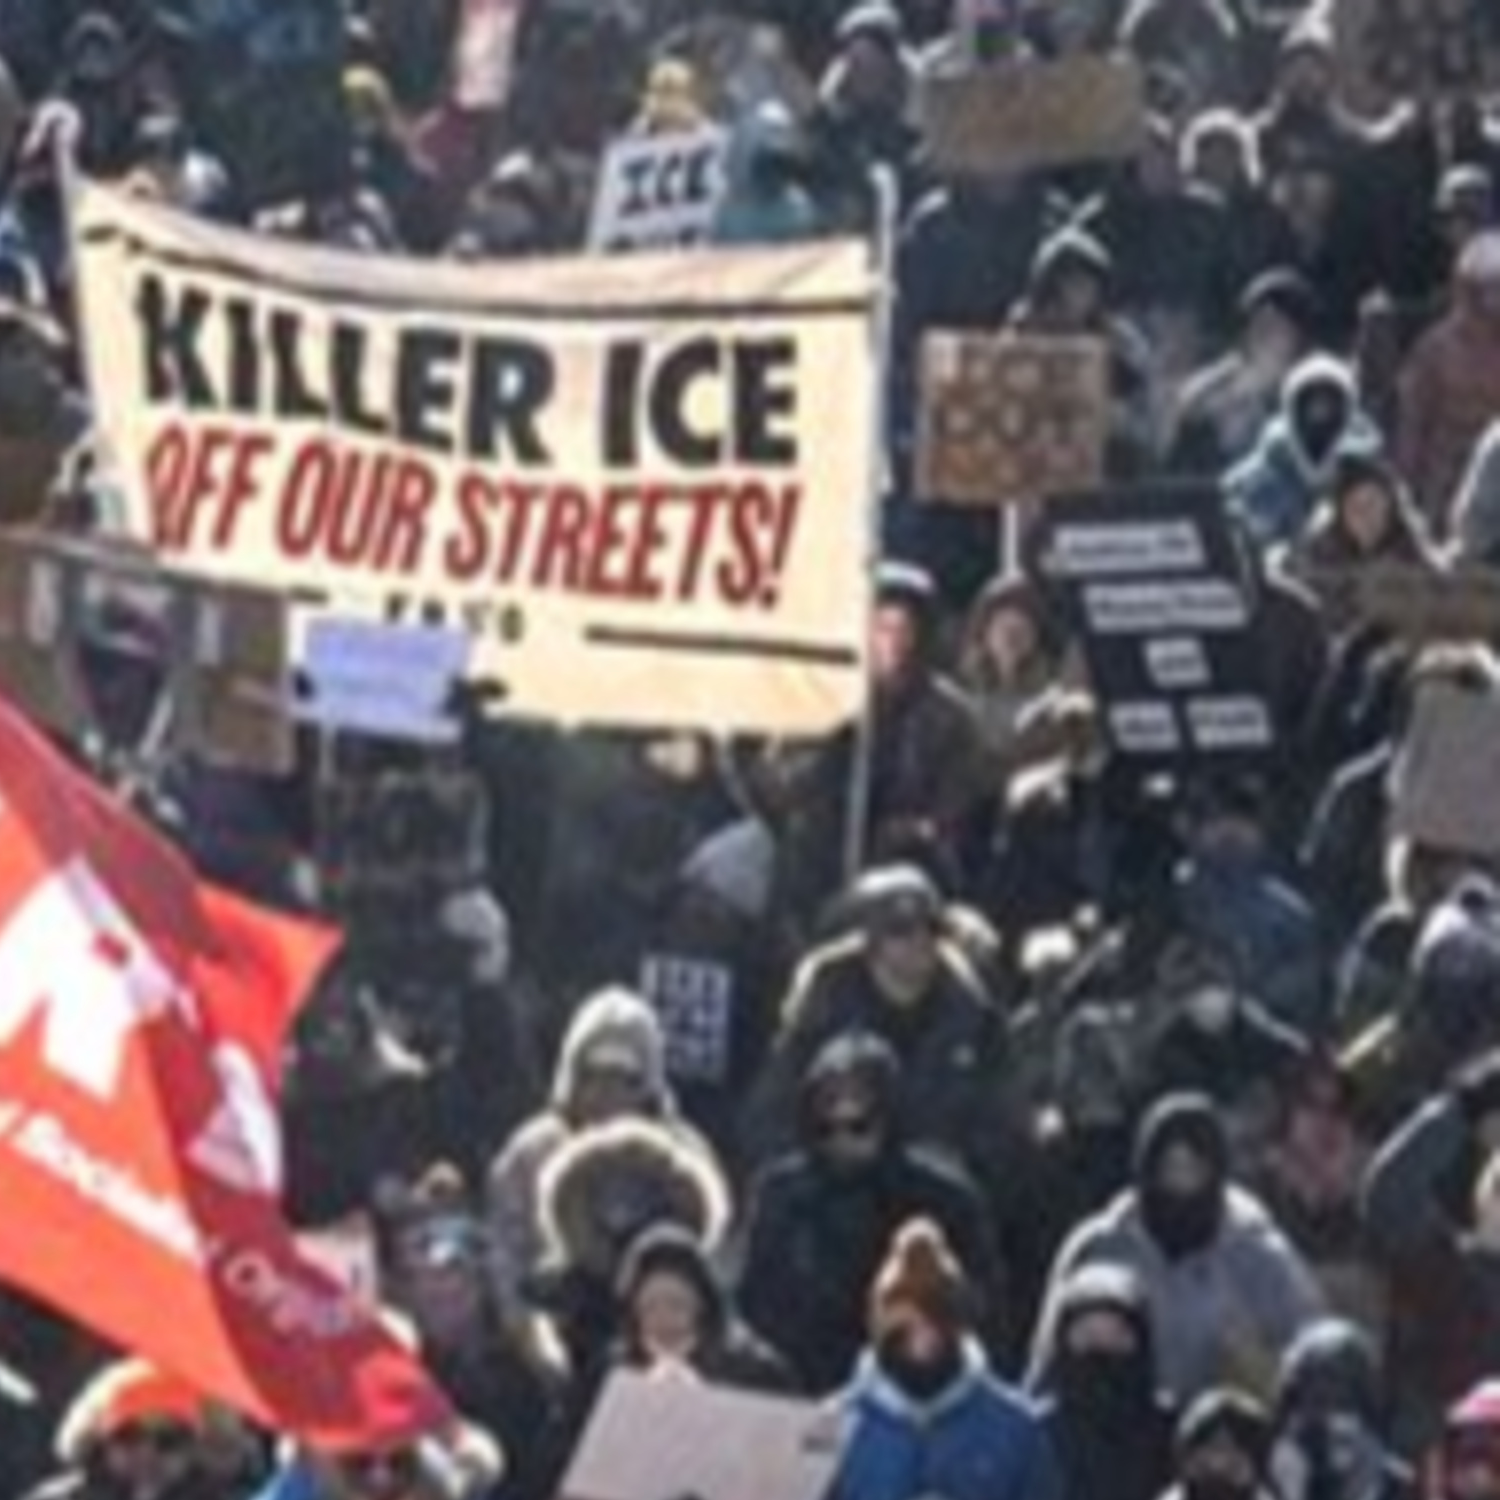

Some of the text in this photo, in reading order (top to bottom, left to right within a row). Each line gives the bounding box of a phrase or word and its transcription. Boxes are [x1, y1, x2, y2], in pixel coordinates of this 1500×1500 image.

[137, 272, 557, 468] KILLER
[608, 333, 798, 470] ICE
[146, 420, 804, 611] OFF OUR STREETS!
